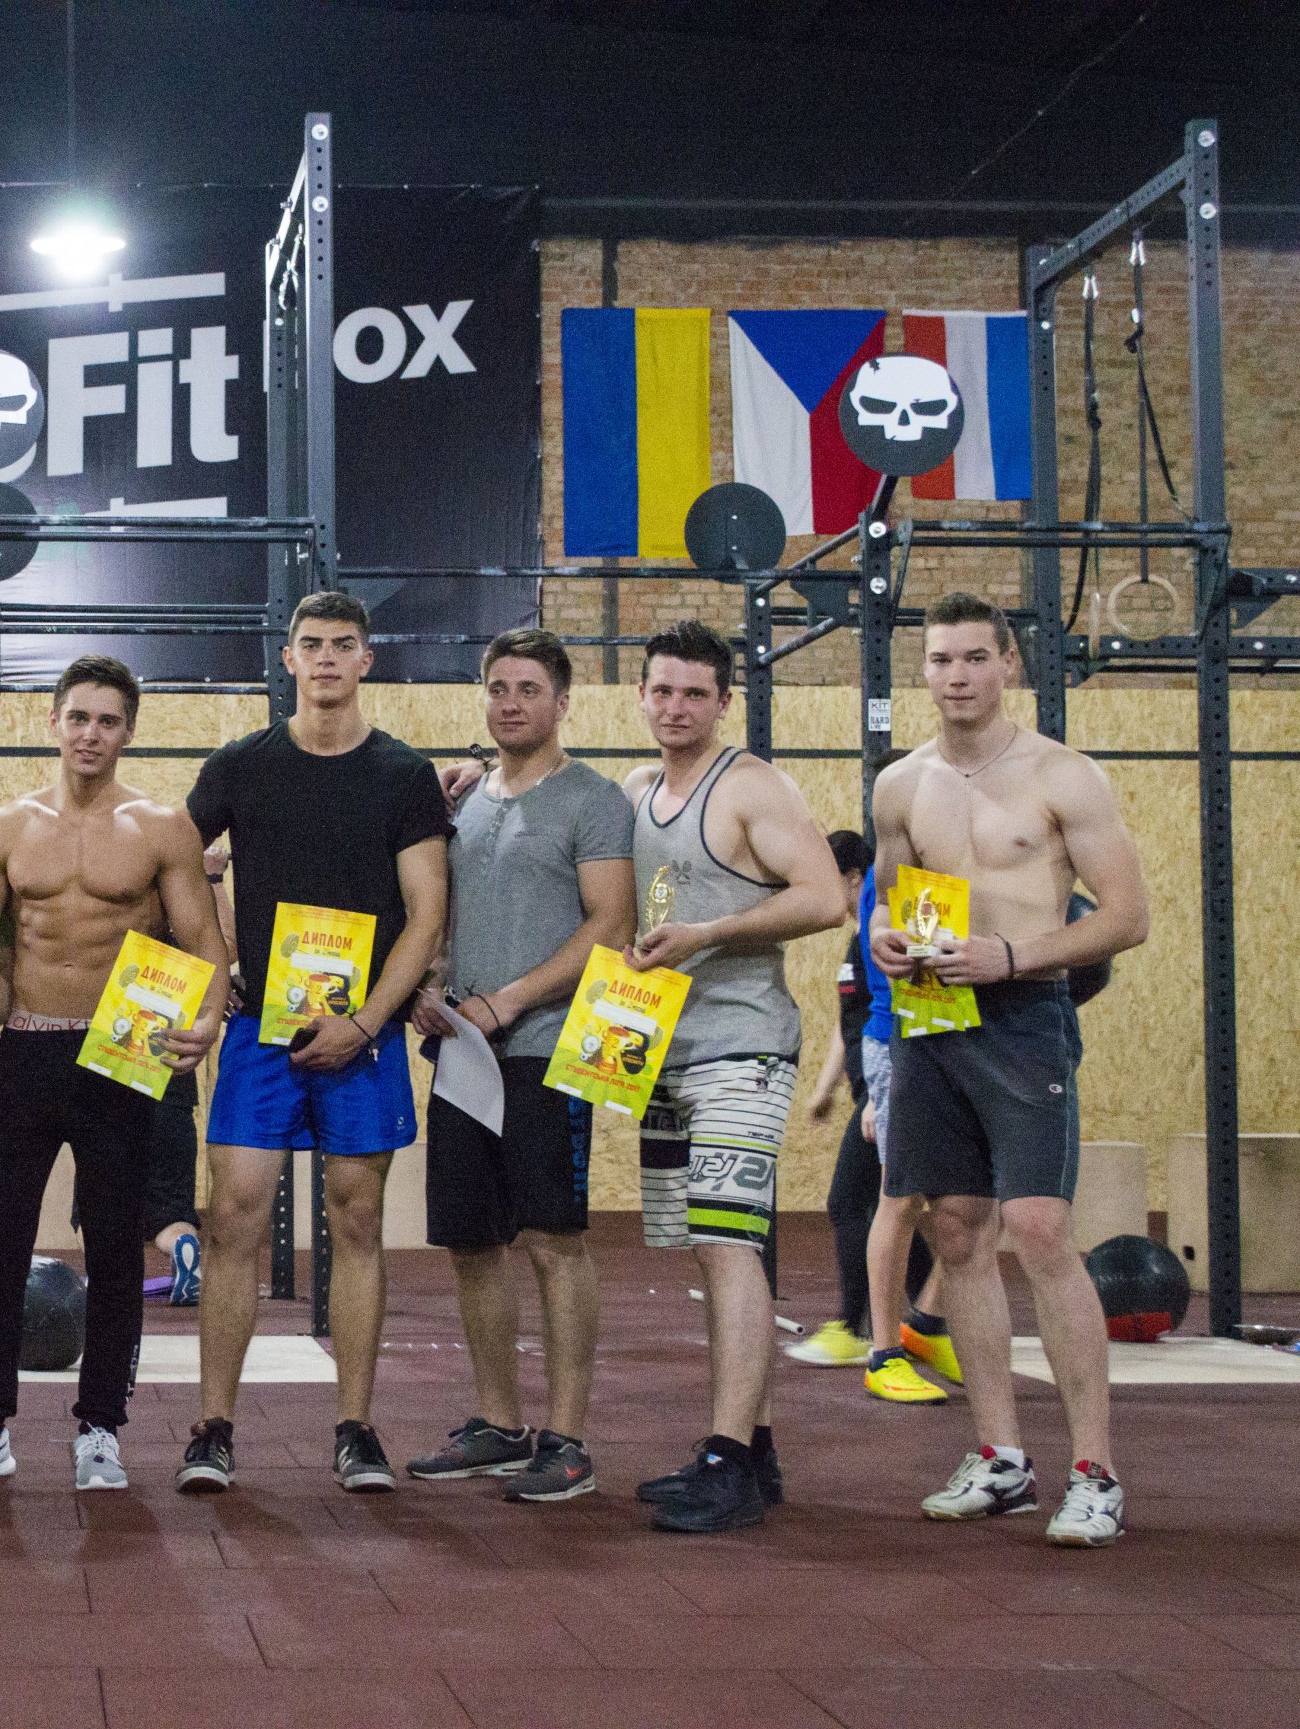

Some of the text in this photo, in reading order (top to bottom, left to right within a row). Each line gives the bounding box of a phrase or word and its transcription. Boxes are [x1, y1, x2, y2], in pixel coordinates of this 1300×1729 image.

[263, 299, 478, 393] ox
[302, 931, 353, 950] ДИПЛОМ
[140, 966, 188, 994] ДИПЛОМ
[608, 980, 662, 1009] ДИПЛОМ
